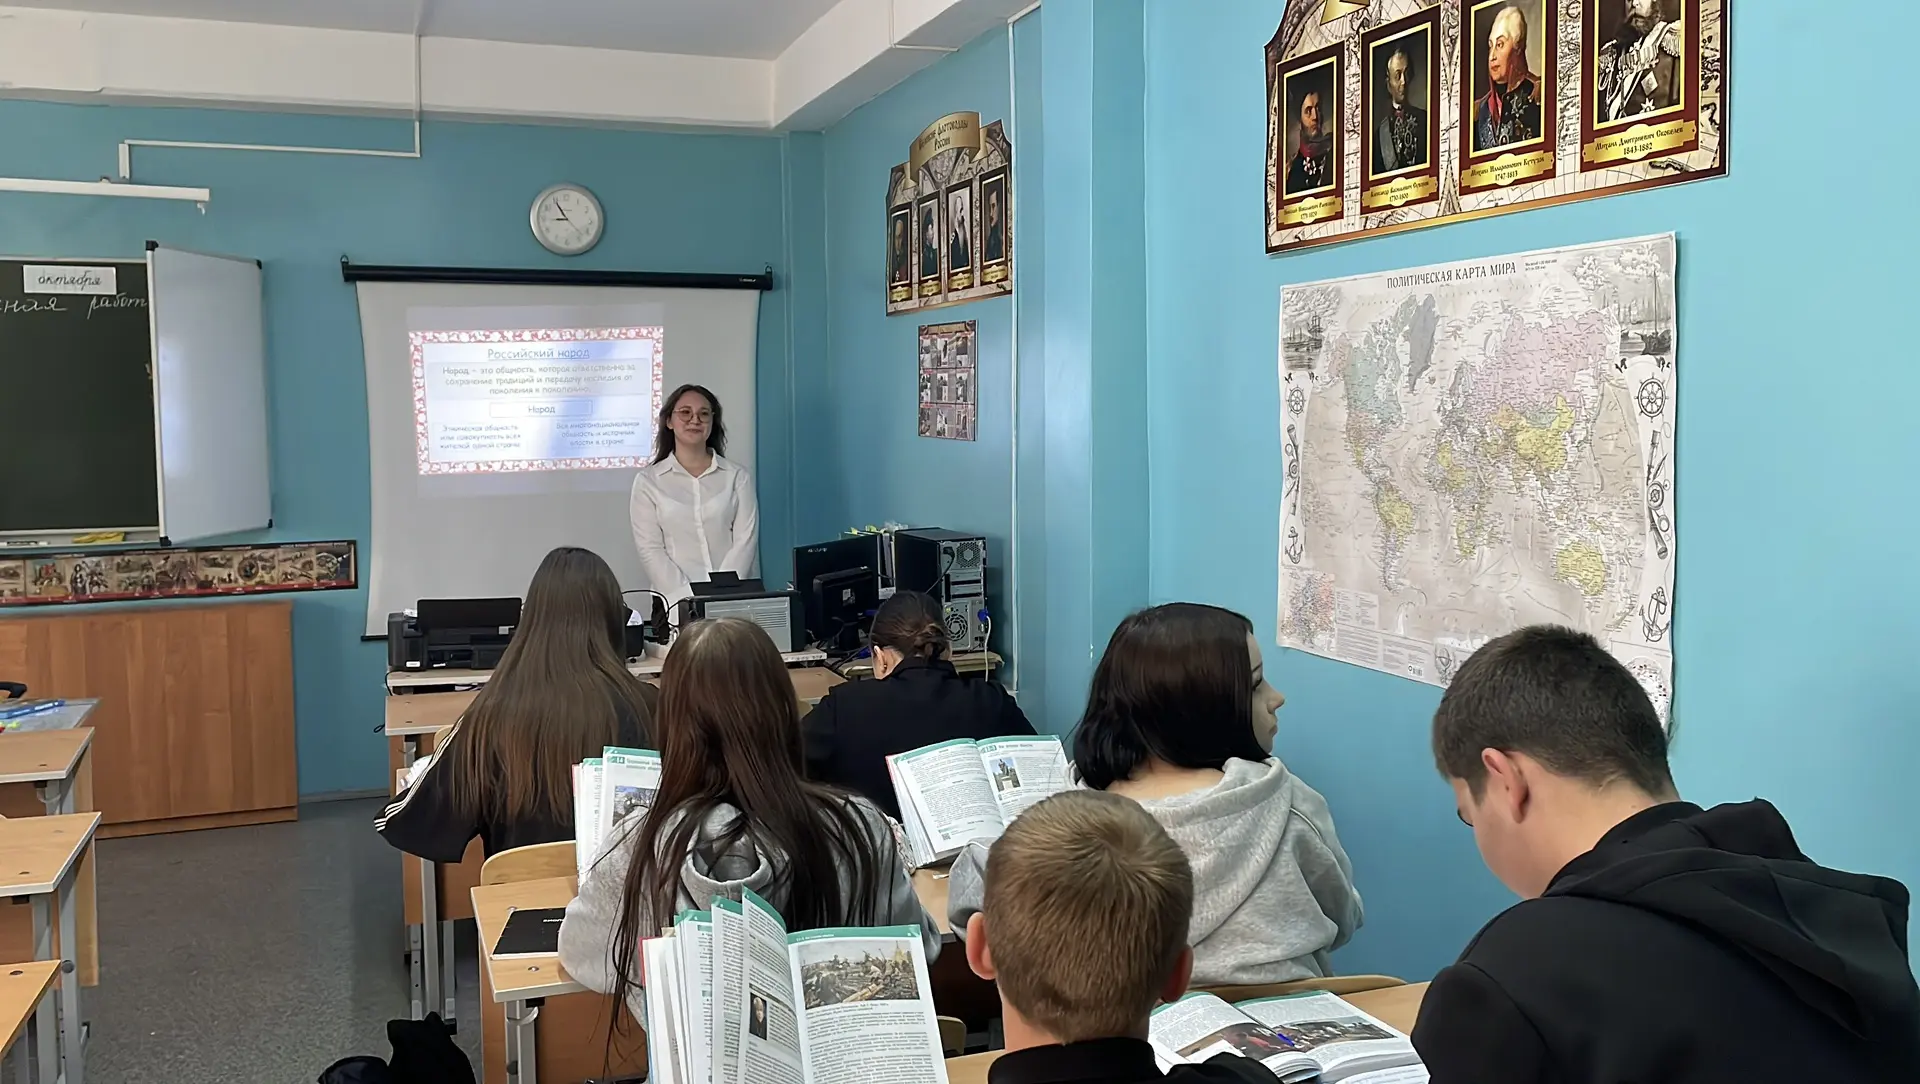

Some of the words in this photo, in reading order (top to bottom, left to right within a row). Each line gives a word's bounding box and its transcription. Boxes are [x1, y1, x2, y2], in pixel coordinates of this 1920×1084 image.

[1623, 142, 1653, 156] 1843-1882
[38, 270, 102, 291] октября
[1387, 269, 1453, 289] ПОЛИТИЧЕСКАЯ
[1455, 266, 1487, 281] КАРТА
[1489, 262, 1517, 276] МИРА
[0, 296, 68, 313] ная
[87, 292, 148, 320] работ
[487, 348, 554, 359] Российский
[557, 349, 590, 360] народ
[442, 366, 469, 376] Народ
[528, 405, 556, 414] Народ
